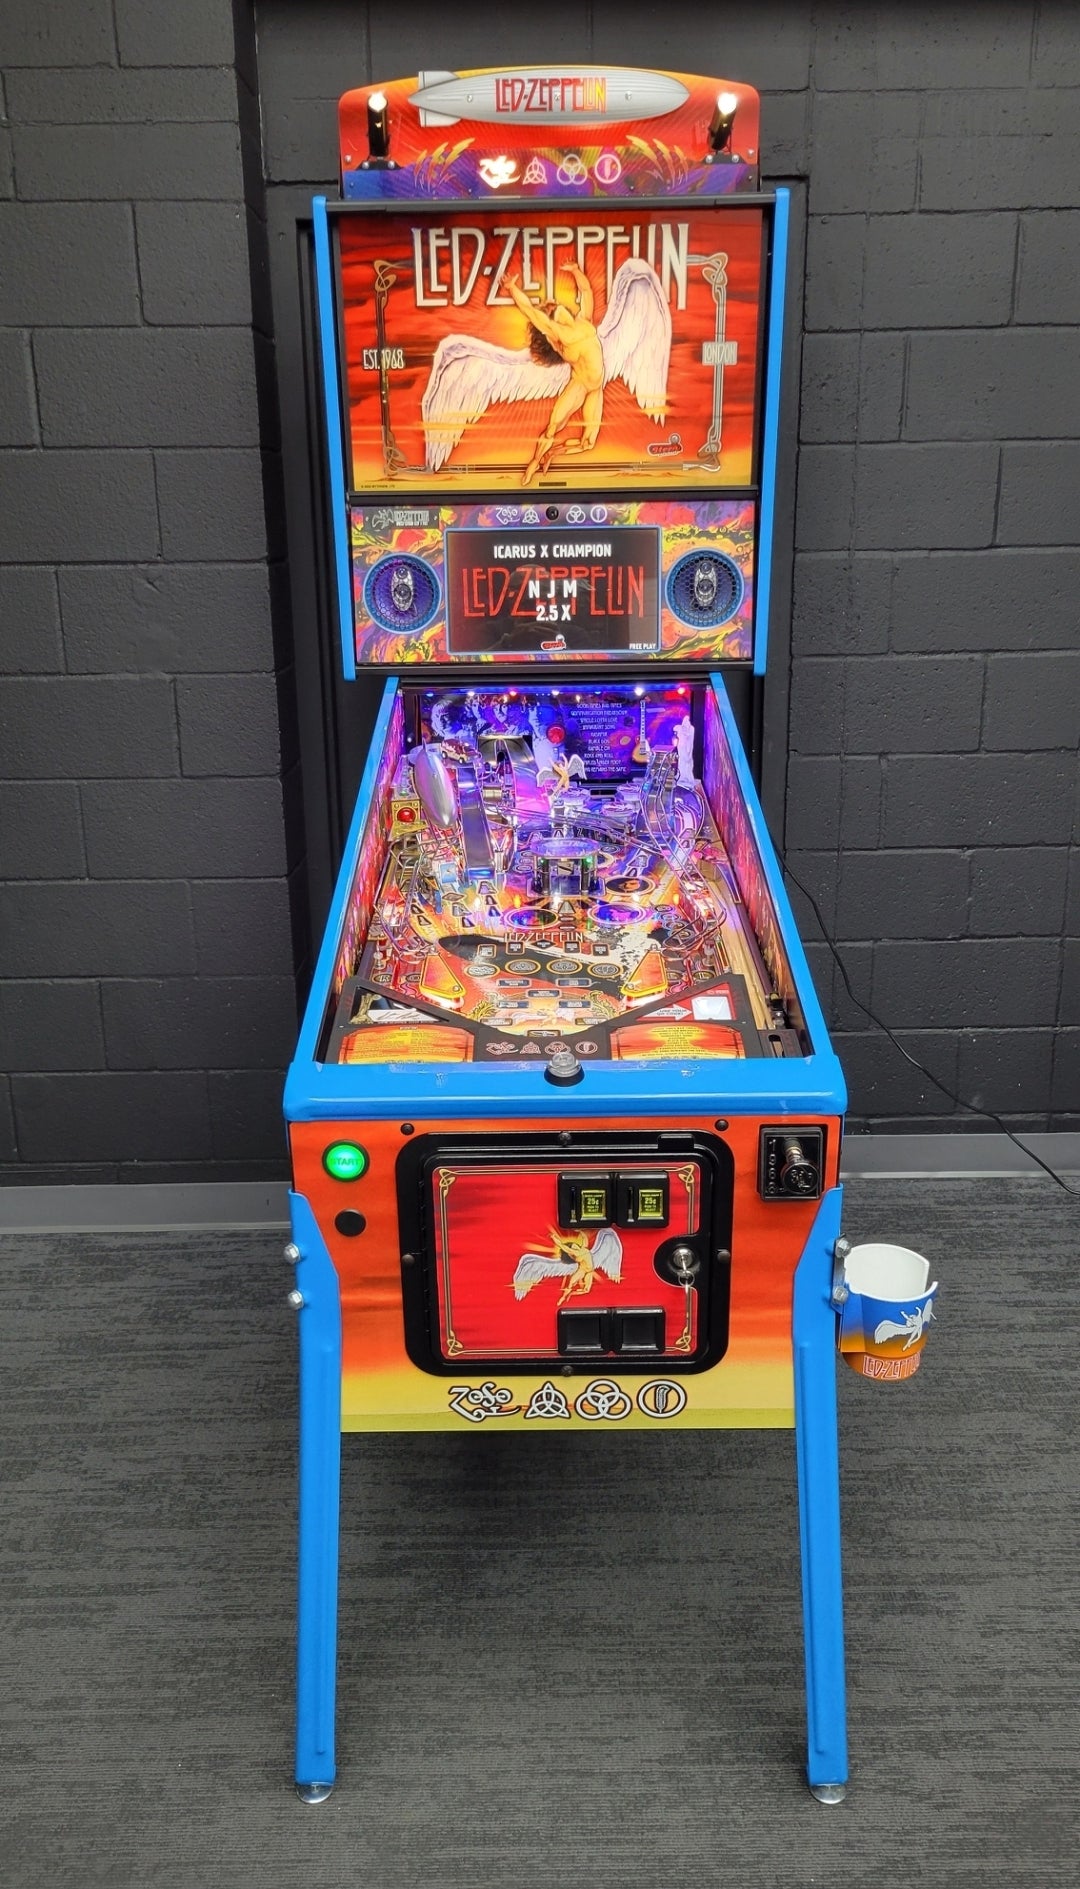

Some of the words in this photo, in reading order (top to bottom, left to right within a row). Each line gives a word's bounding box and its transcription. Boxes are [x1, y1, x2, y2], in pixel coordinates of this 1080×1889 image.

[495, 77, 607, 114] LED-ZEPPELIN
[363, 349, 380, 370] EST.
[381, 349, 405, 370] 1968
[494, 544, 536, 559] ICARUS
[540, 545, 549, 558] X
[552, 543, 612, 558] CHAMPION
[528, 580, 540, 599] N
[547, 580, 556, 598] J
[563, 580, 577, 598] M
[536, 605, 559, 622] 2.5
[561, 605, 572, 621] X
[332, 1158, 358, 1166] START
[644, 1197, 656, 1205] 25¢
